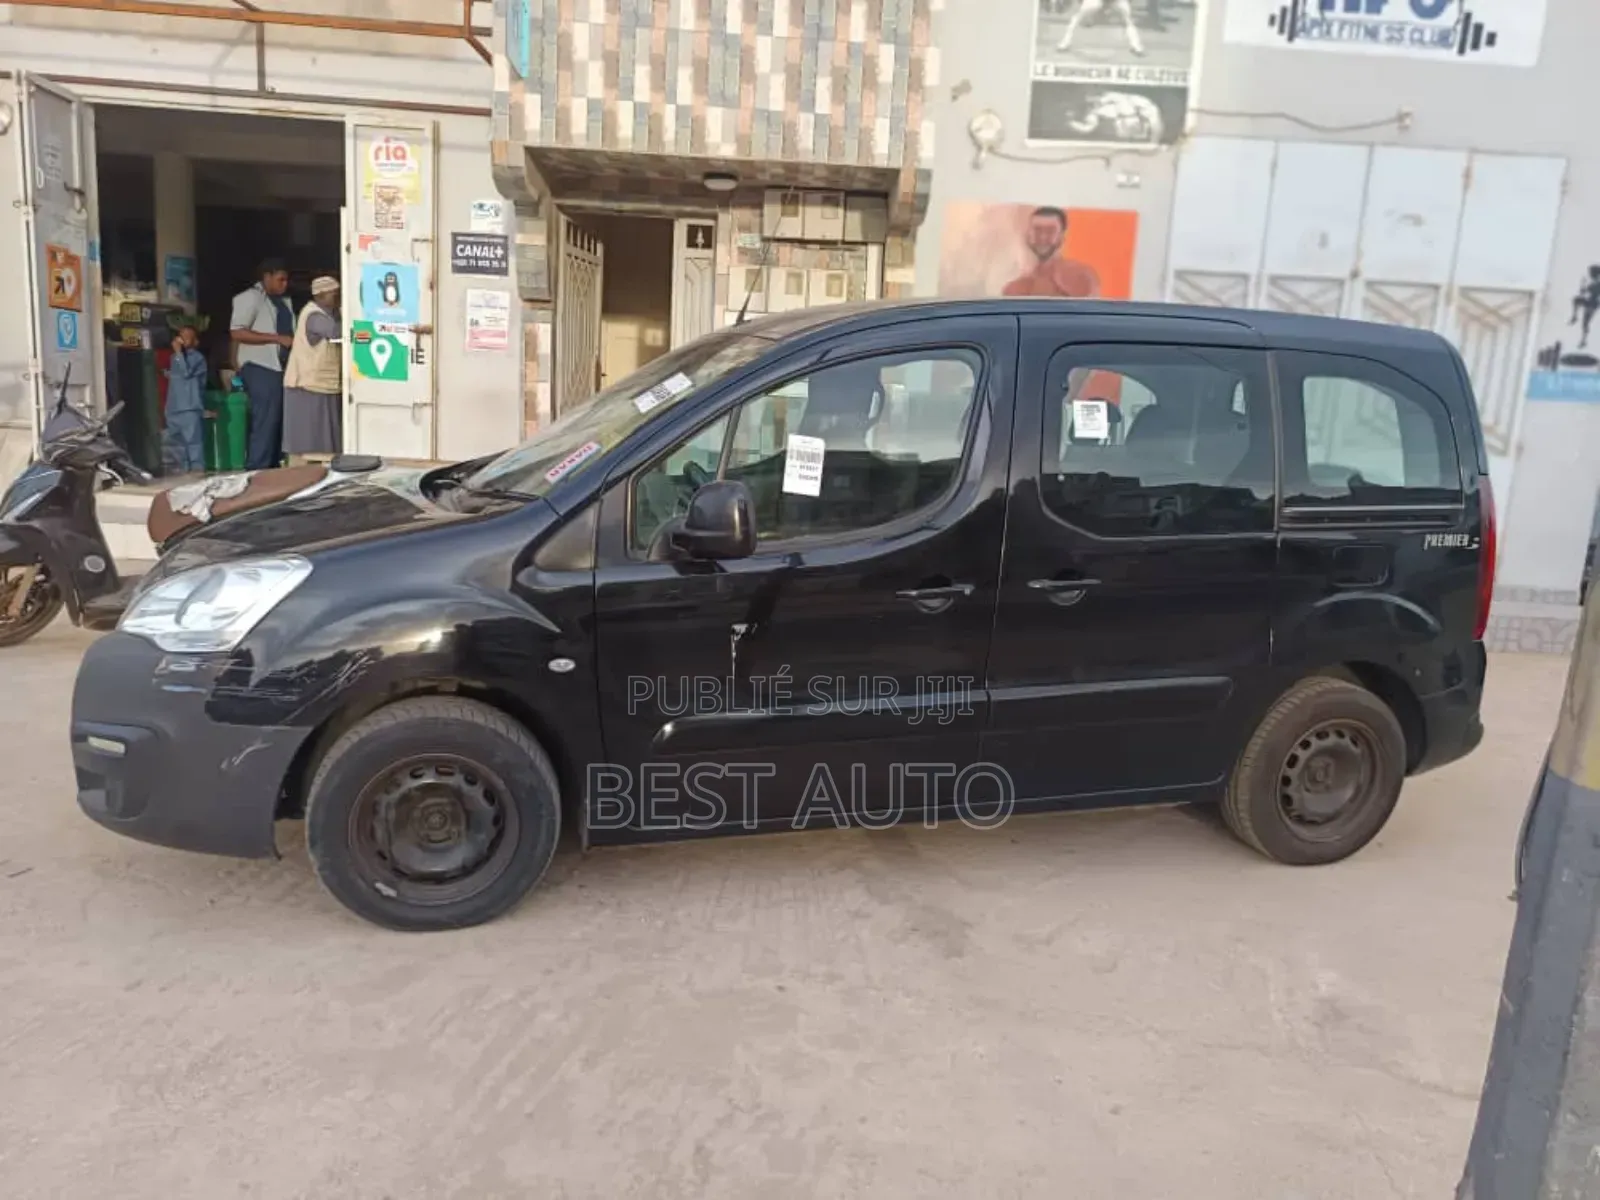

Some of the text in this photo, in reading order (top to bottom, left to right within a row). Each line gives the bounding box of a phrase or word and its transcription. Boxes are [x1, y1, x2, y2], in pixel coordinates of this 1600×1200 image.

[374, 136, 406, 161] ria
[456, 243, 504, 258] CANAL+
[1423, 533, 1469, 550] PREMIER
